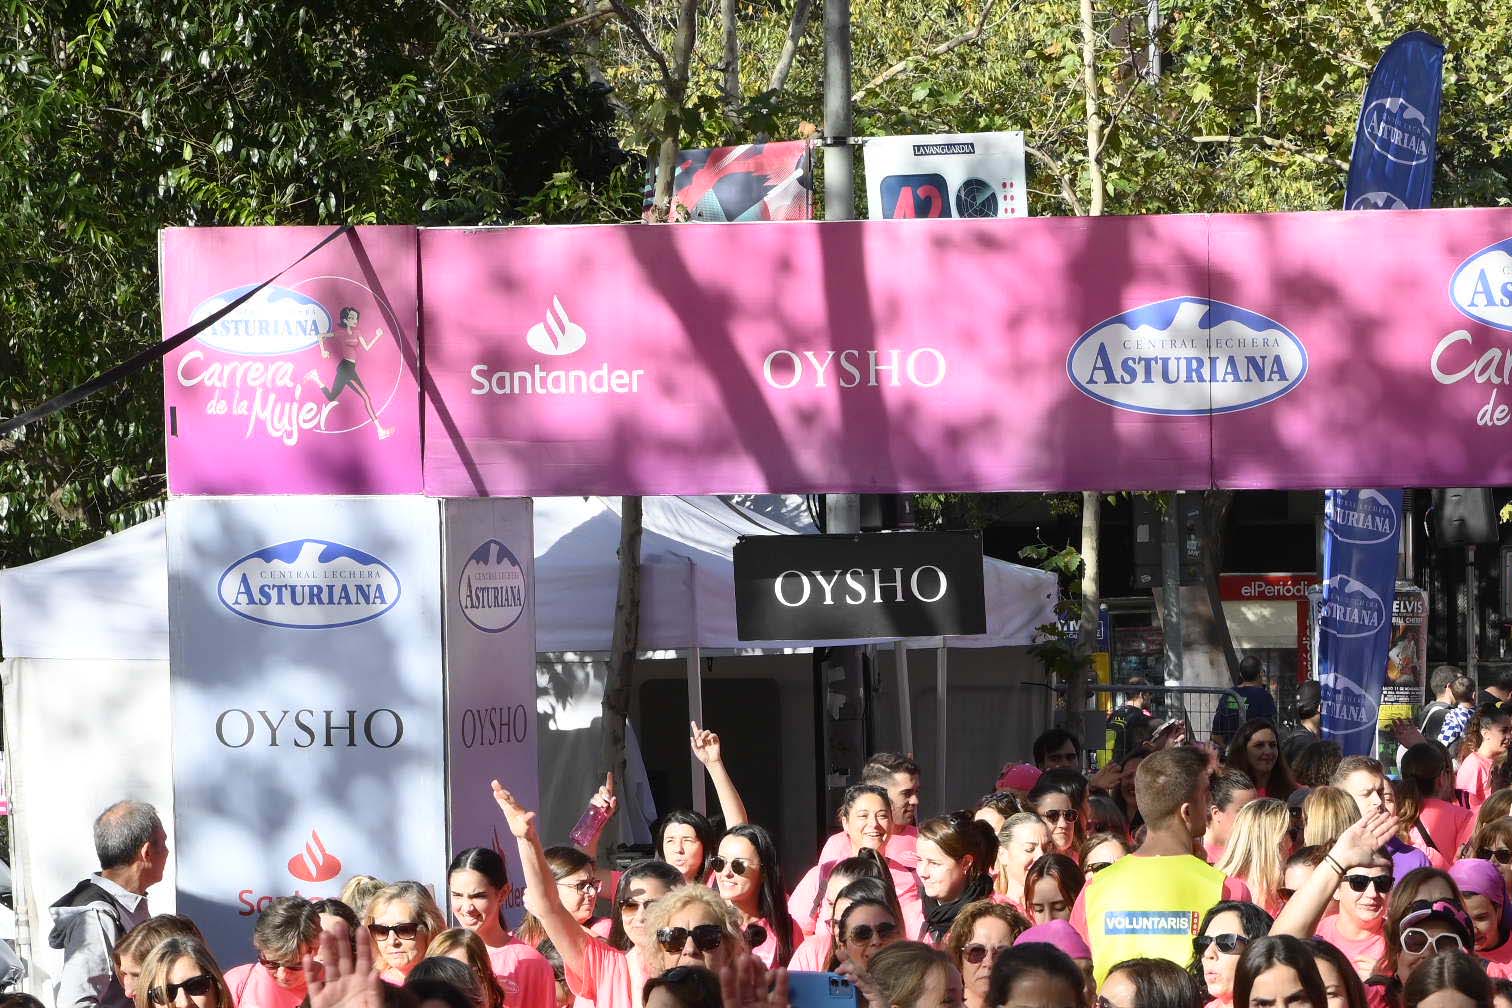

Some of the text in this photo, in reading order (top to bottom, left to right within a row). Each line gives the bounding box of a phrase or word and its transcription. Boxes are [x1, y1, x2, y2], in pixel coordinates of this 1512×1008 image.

[914, 144, 974, 155] LA VANGUARDIA
[200, 311, 321, 337] ASTURIANA
[1123, 337, 1280, 350] CENTRAL LECHERA
[177, 350, 294, 388] Carrera
[470, 362, 644, 396] Santander
[762, 347, 946, 390] OYSHO
[1085, 342, 1289, 384] ASTURIANA
[206, 384, 340, 446] de la Mujer
[1476, 389, 1510, 427] de
[232, 572, 389, 607] ASTURIANA
[259, 569, 381, 580] CENTRAL LECHERA
[464, 574, 523, 610] ASTURIANA
[774, 565, 948, 607] OYSHO
[1241, 581, 1308, 596] elPeriódi
[1392, 600, 1423, 613] ELVIS
[215, 708, 404, 749] OYSHO
[461, 704, 528, 749] OYSHO
[1106, 916, 1189, 930] VOLUNTARIS
